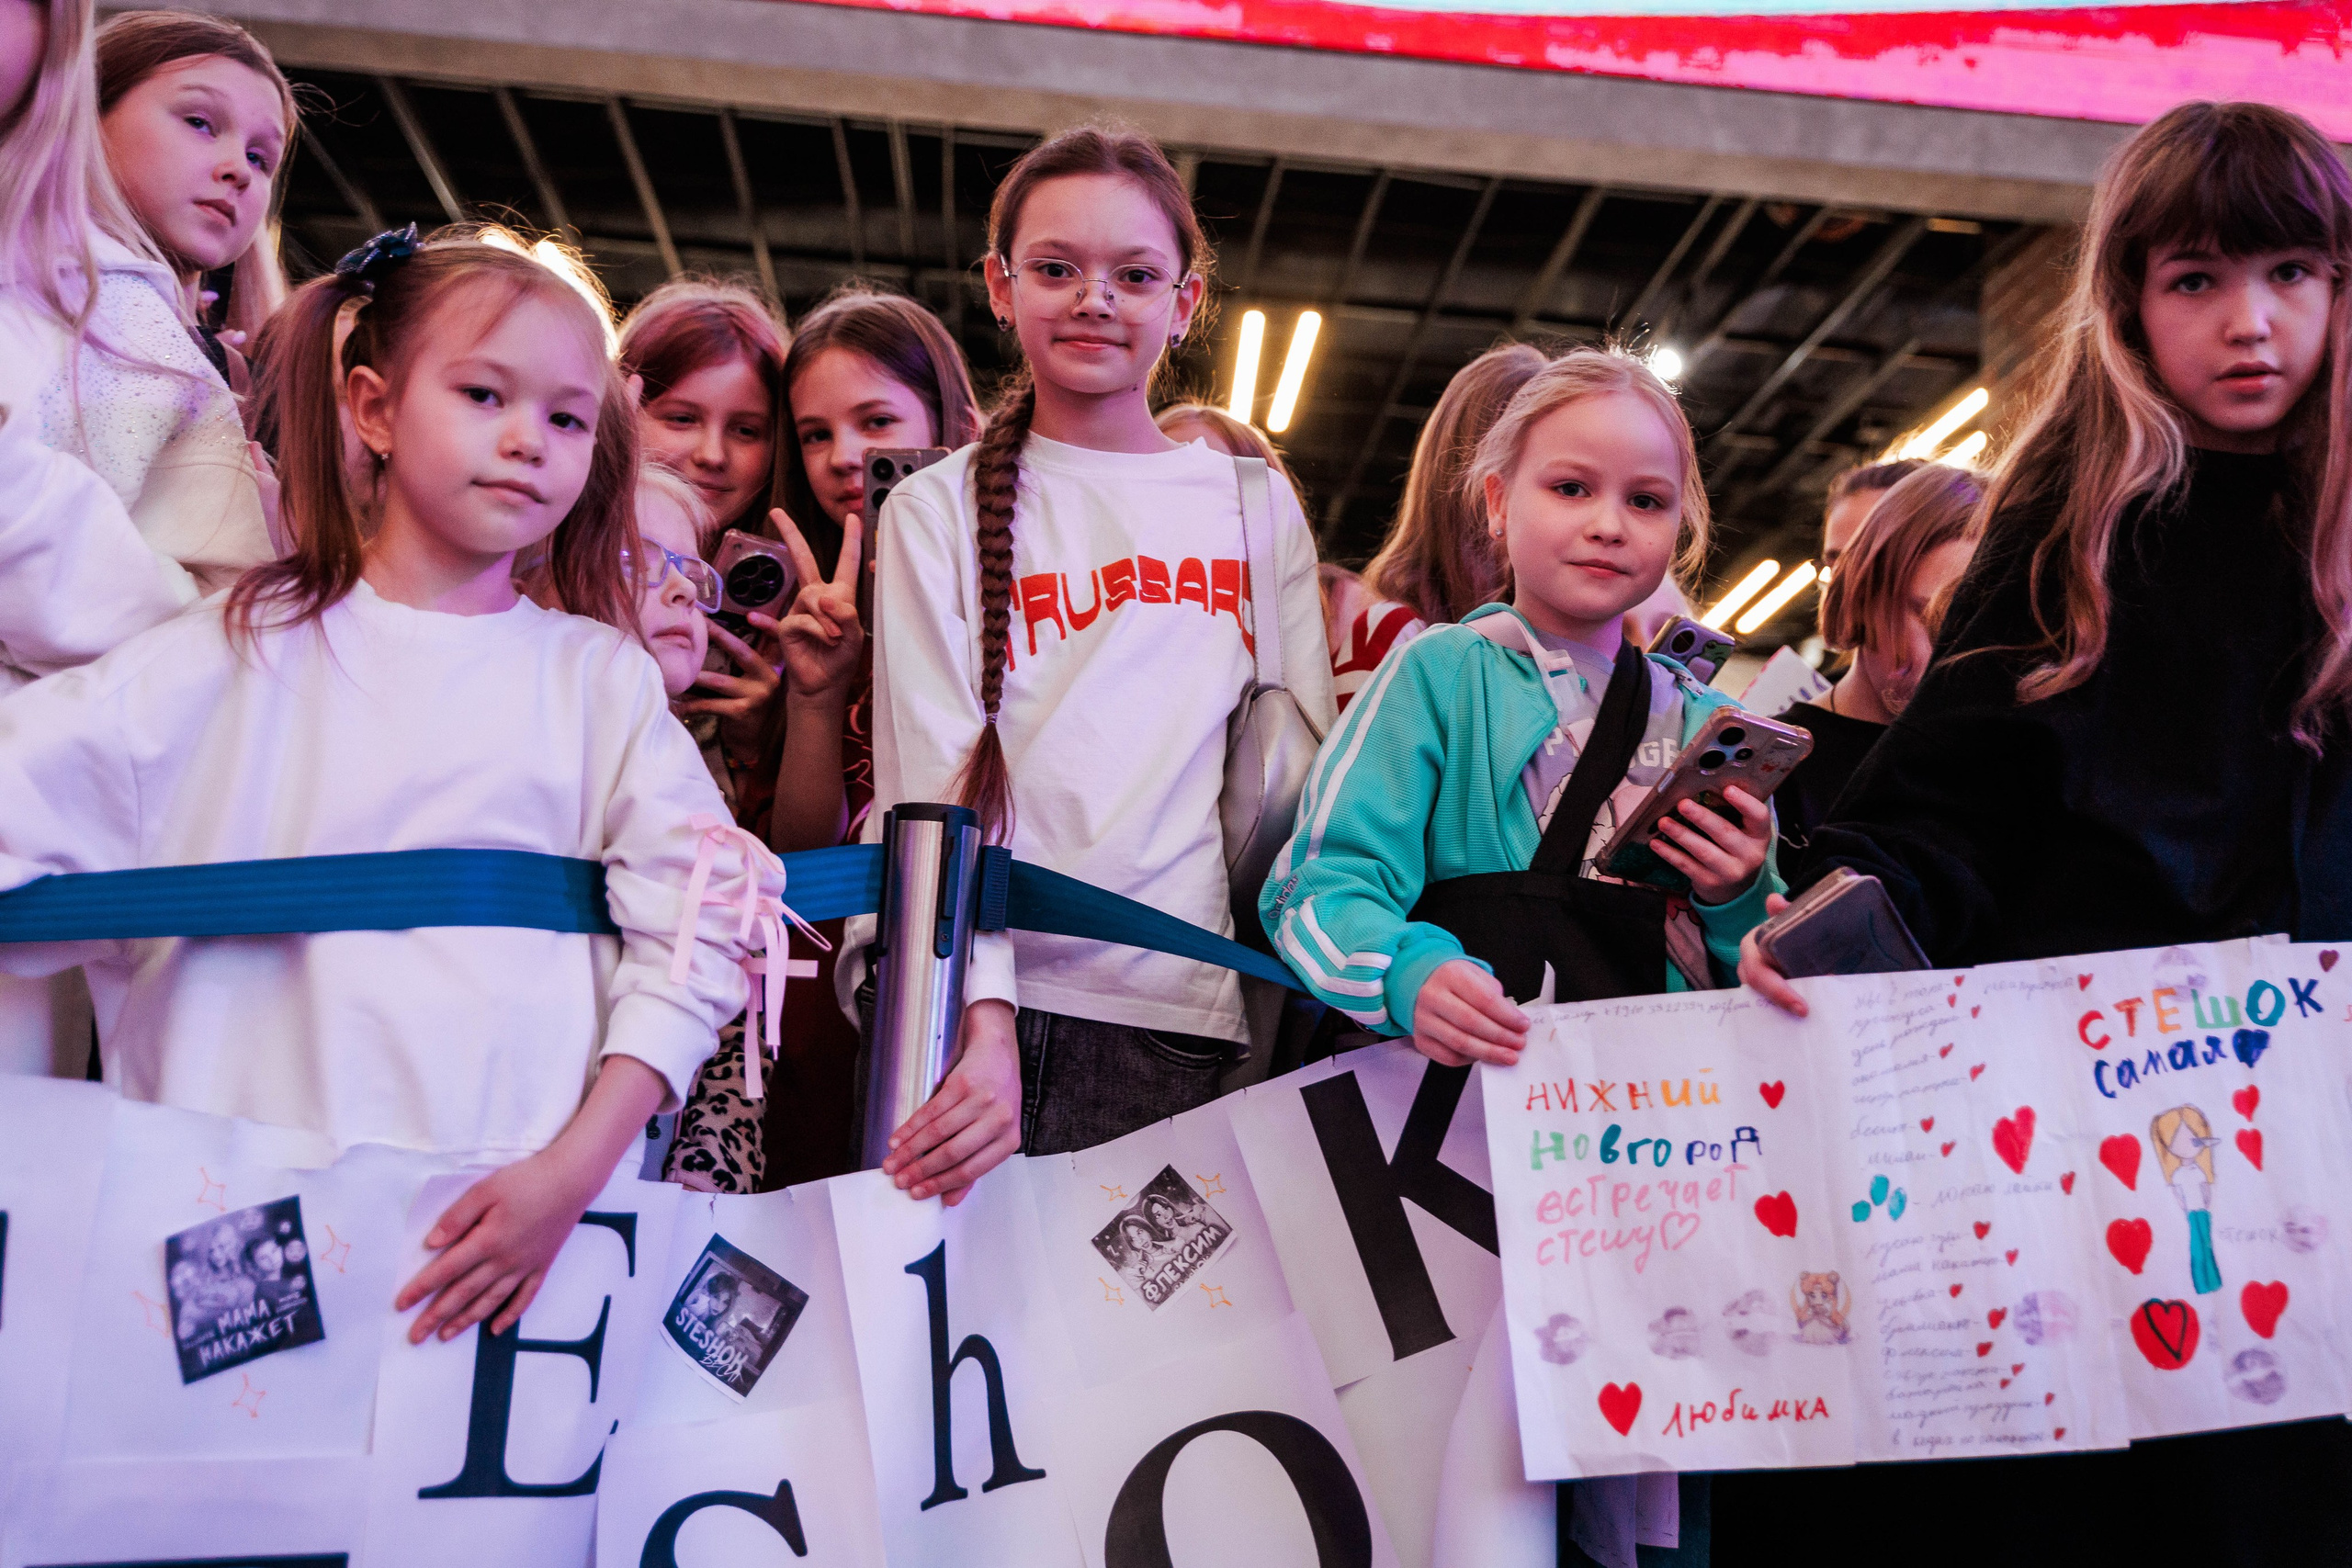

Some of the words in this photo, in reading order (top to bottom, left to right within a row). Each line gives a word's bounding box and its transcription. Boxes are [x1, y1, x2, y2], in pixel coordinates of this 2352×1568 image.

[2077, 977, 2324, 1051] СТЕШОК
[1144, 1226, 1223, 1303] ФЛЕКСИМ
[198, 1310, 299, 1367] НАКАЖЕТ
[218, 1299, 271, 1335] МАМА
